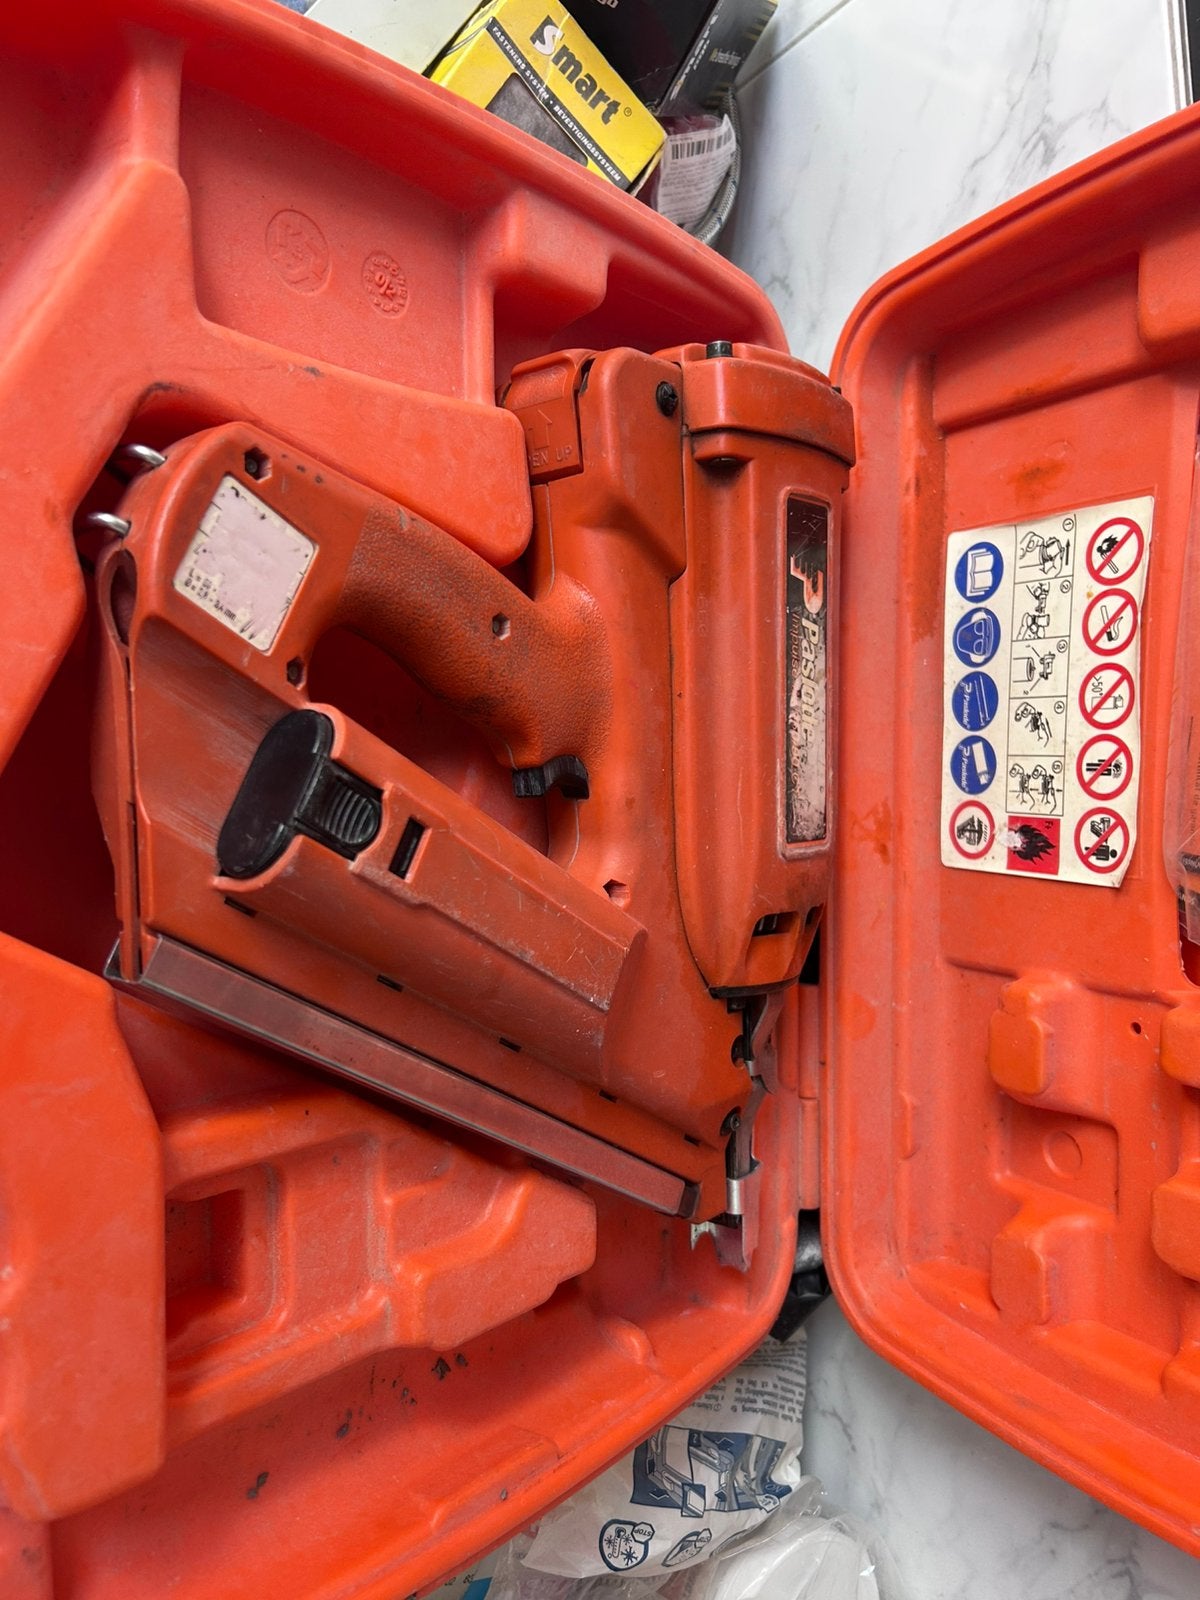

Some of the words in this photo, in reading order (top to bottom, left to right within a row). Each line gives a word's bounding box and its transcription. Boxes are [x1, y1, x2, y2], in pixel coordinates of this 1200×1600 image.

[492, 26, 526, 70] FASTENERS
[525, 69, 550, 100] SYSTEM
[553, 105, 622, 182] BEVESTIGINGSSYSTEEM
[556, 445, 573, 462] UP
[802, 617, 819, 744] Paslode
[634, 1527, 652, 1537] STOP
